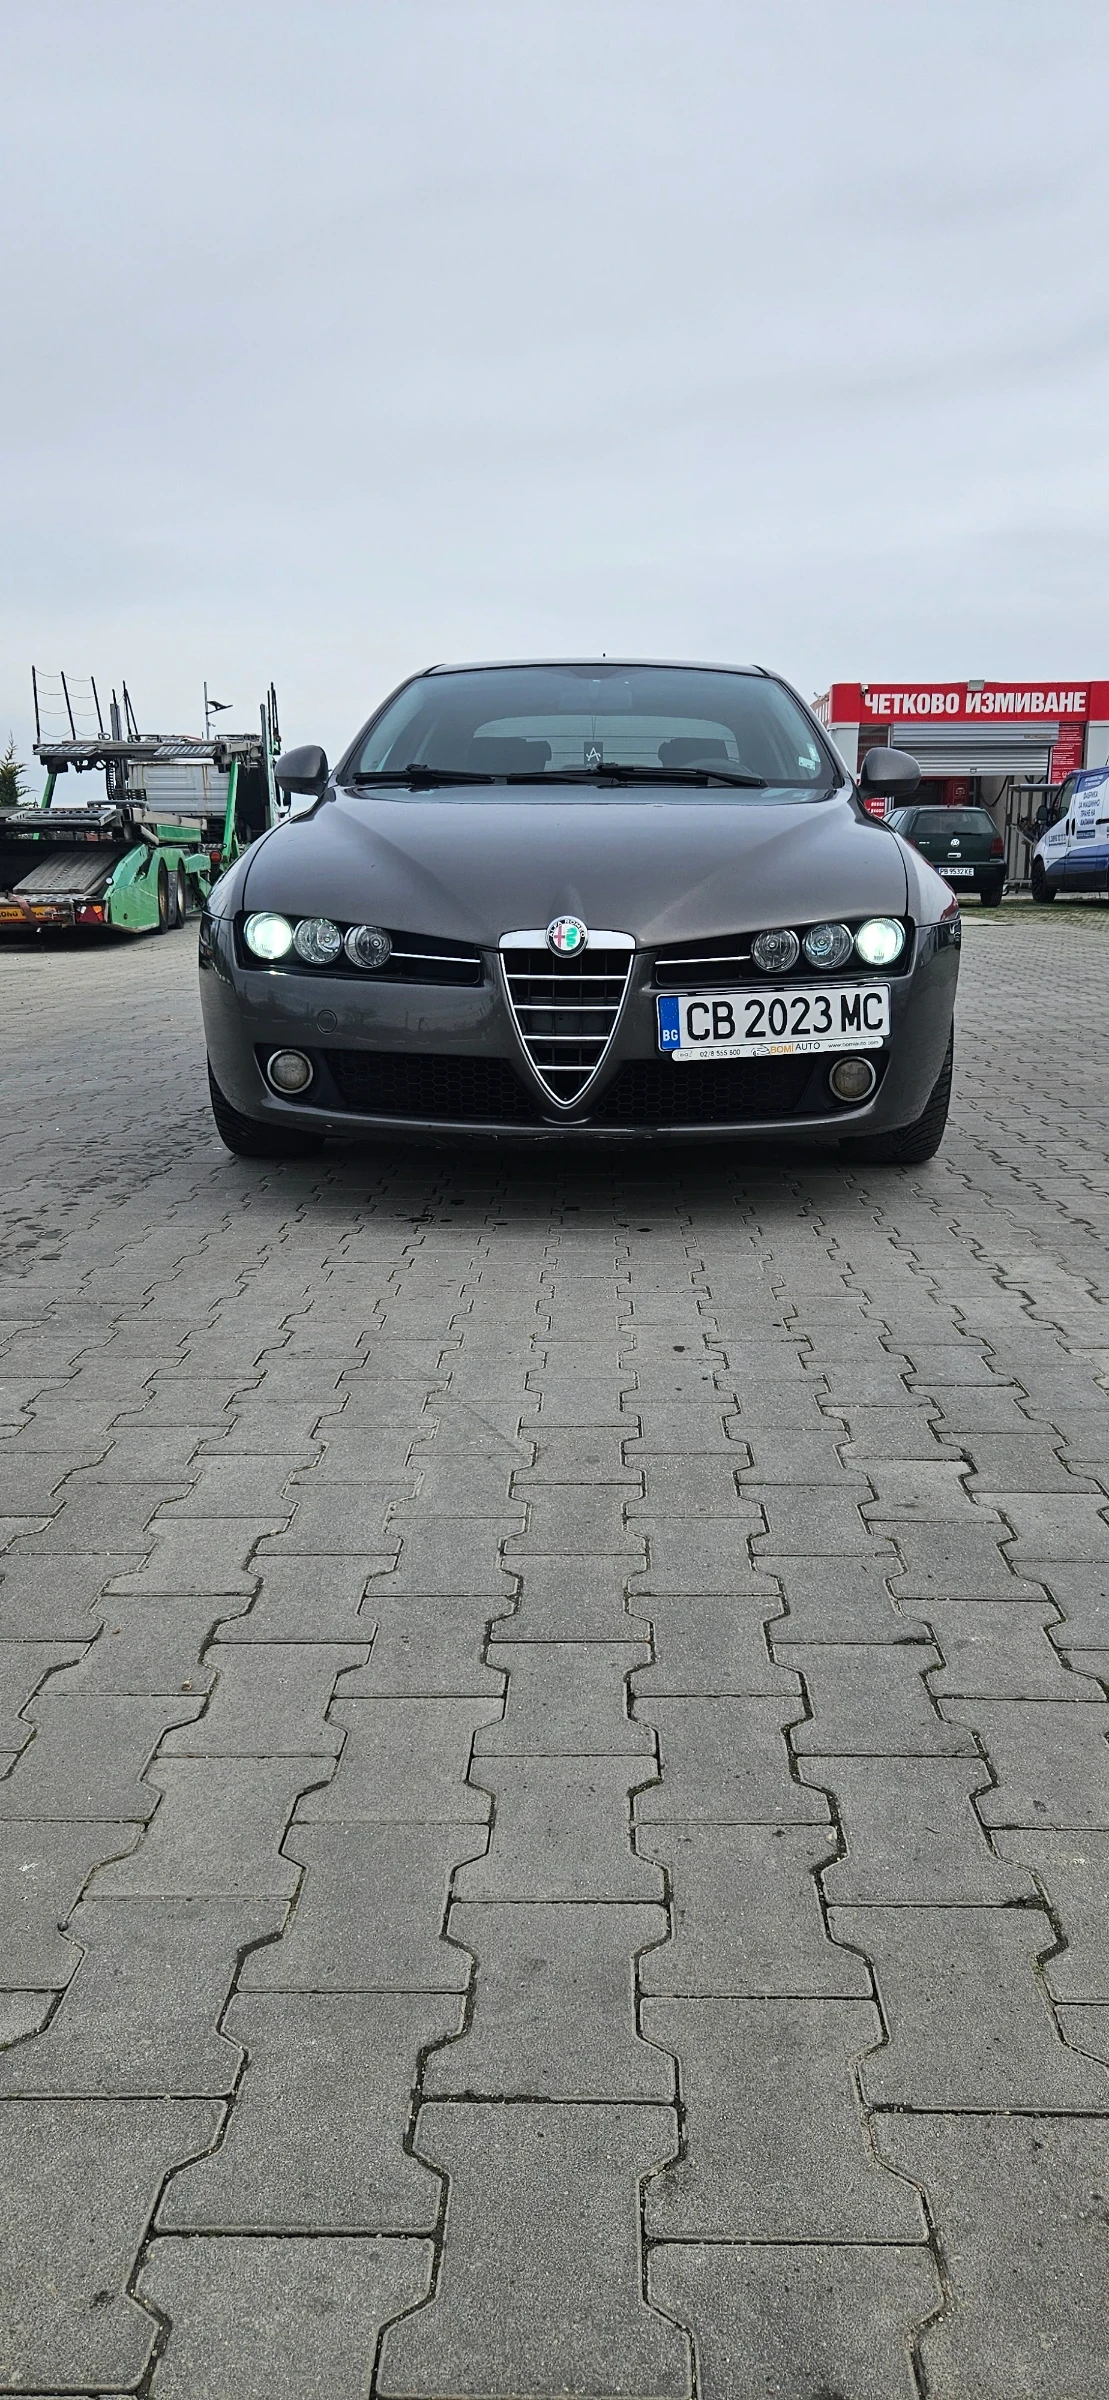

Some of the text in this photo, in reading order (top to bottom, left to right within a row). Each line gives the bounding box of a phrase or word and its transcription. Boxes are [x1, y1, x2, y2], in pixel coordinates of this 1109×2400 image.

[864, 691, 1087, 714] ЧЕТКОВО ИЗМИВАНЕ
[549, 919, 585, 937] ALFA ROMEO
[686, 992, 884, 1041] CB 2023 MC
[662, 1029, 678, 1041] BG
[770, 1043, 794, 1054] BOMI
[795, 1041, 821, 1051] AUTO
